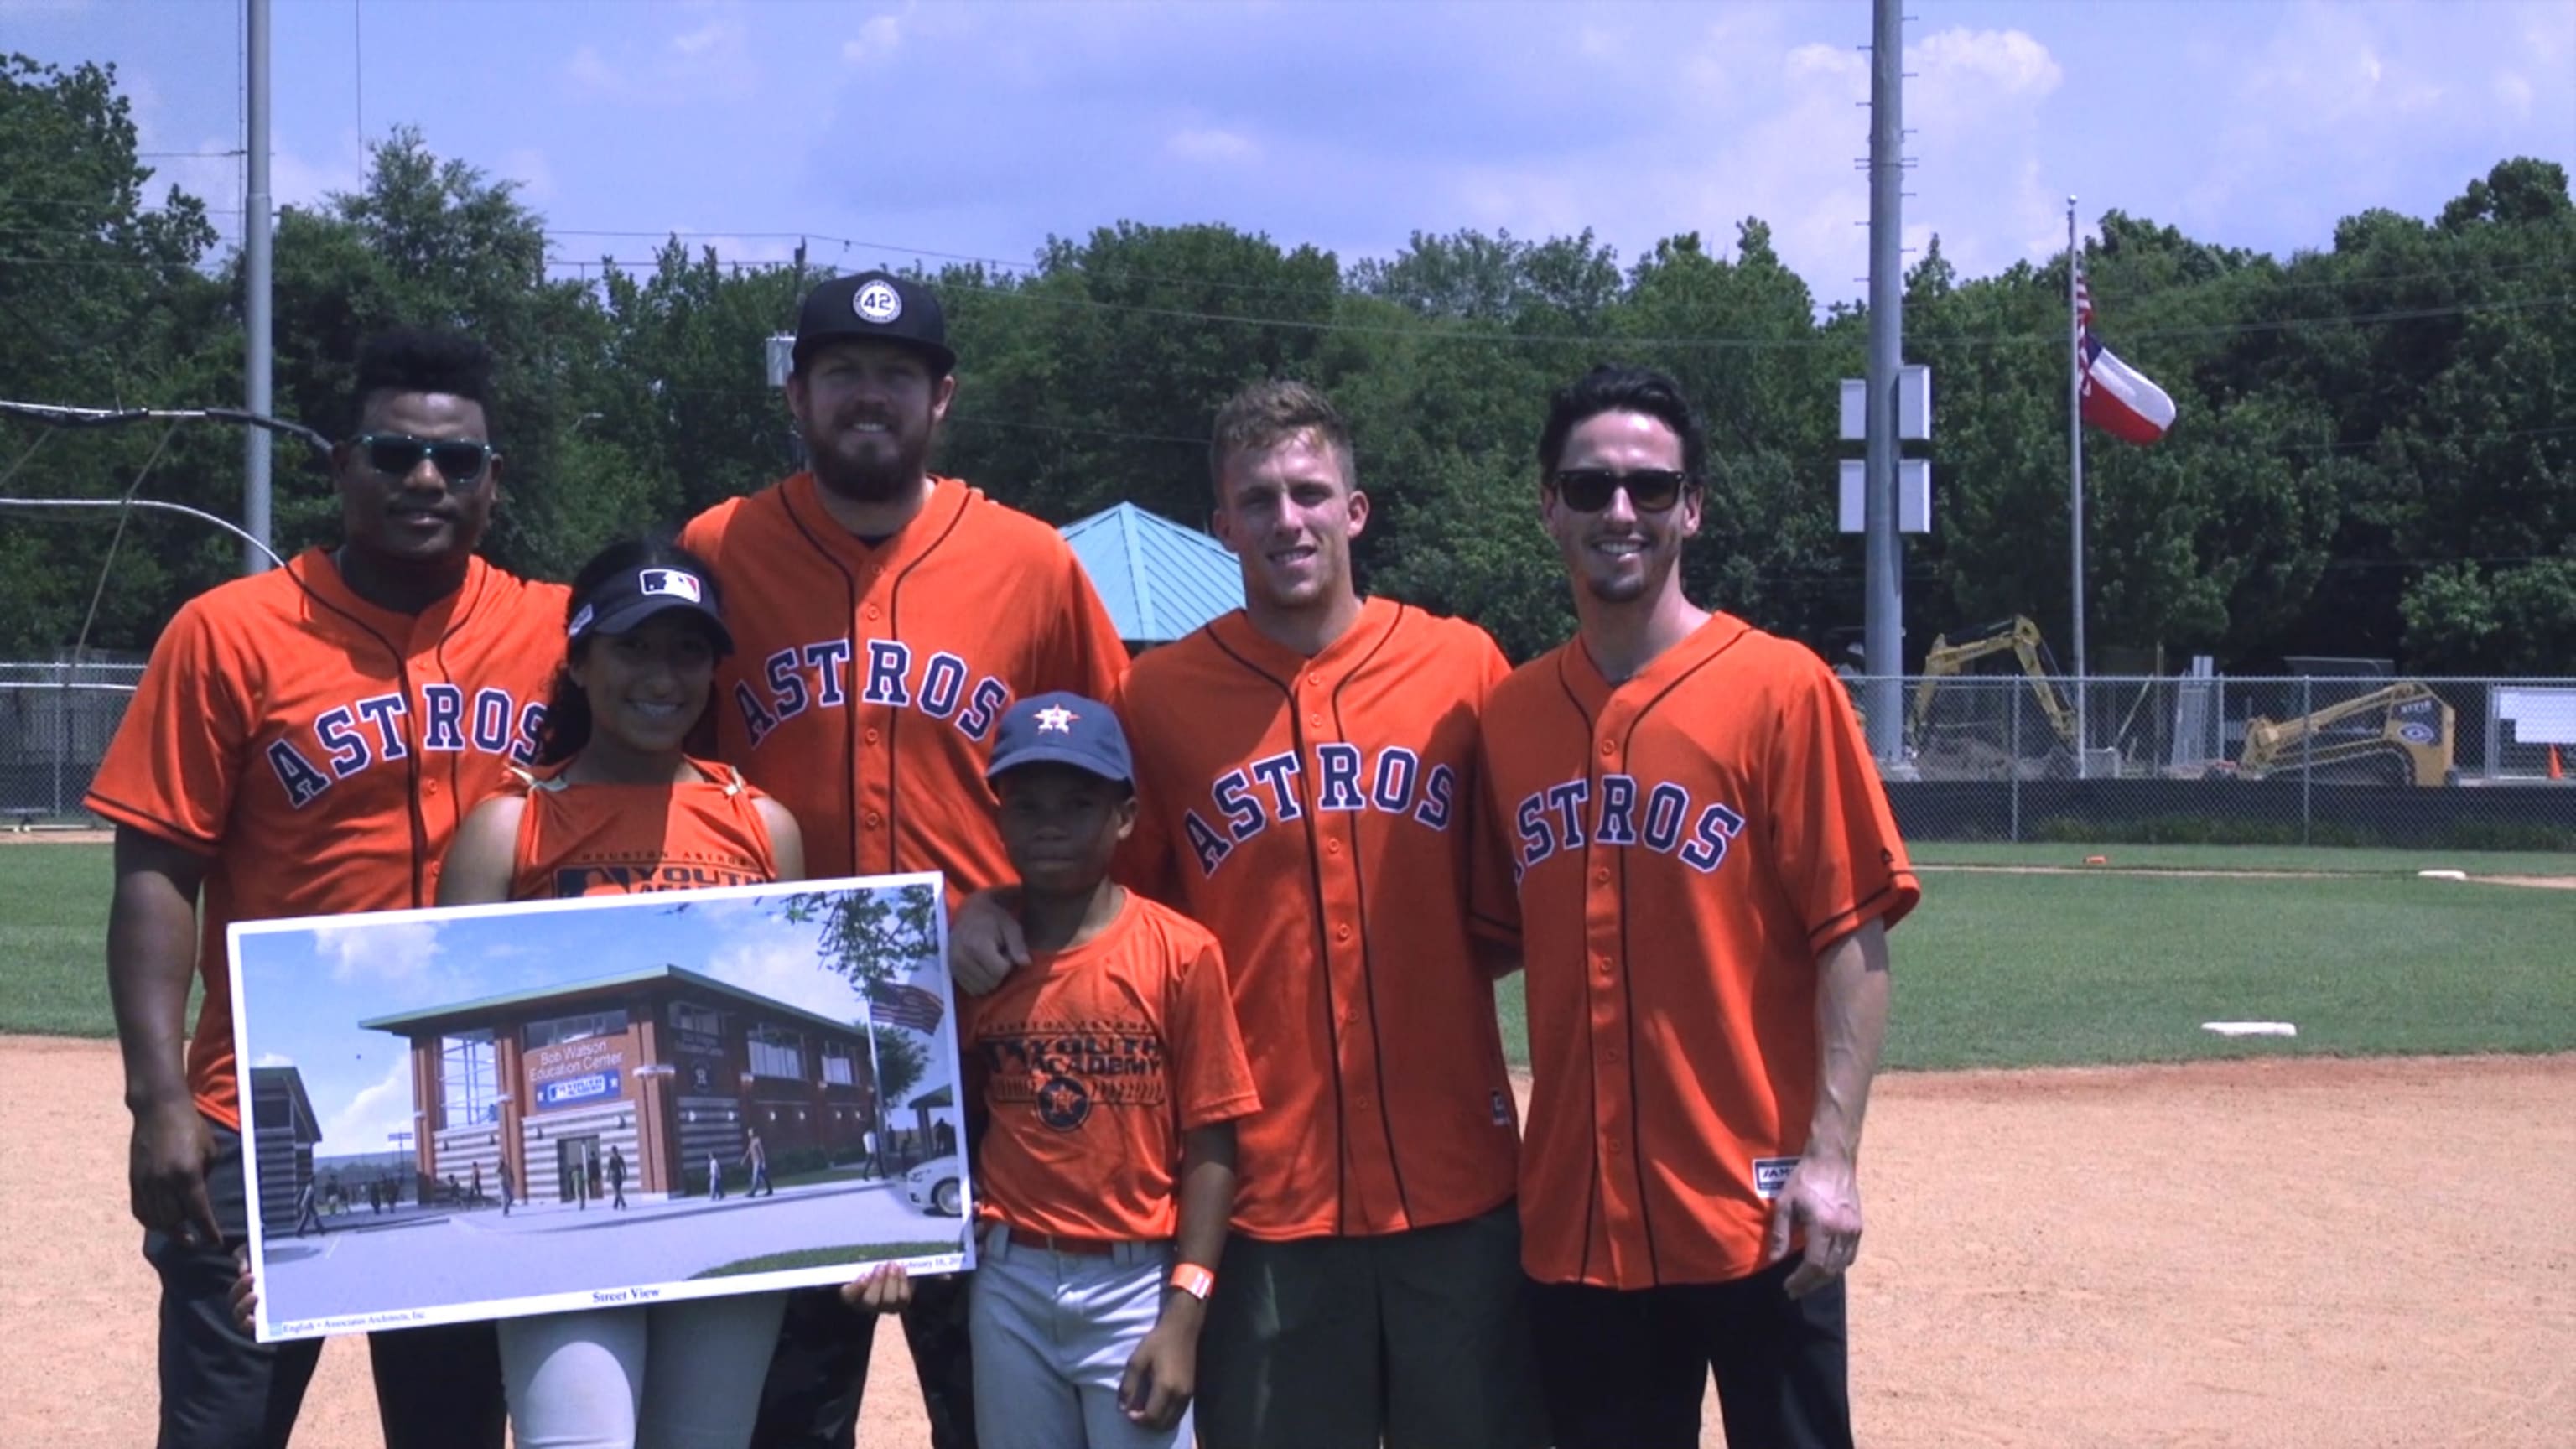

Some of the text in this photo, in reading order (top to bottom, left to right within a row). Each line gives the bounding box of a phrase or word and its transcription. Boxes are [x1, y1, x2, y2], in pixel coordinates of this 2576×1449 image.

[863, 292, 891, 311] 42
[733, 638, 1010, 750] ASTROS
[266, 683, 548, 809] ASTROS
[1183, 742, 1456, 879] ASTROS
[1514, 774, 1746, 879] STROS
[528, 1052, 623, 1082] Education Center
[540, 1041, 607, 1066] Bob Watson
[592, 1287, 660, 1304] Street View
